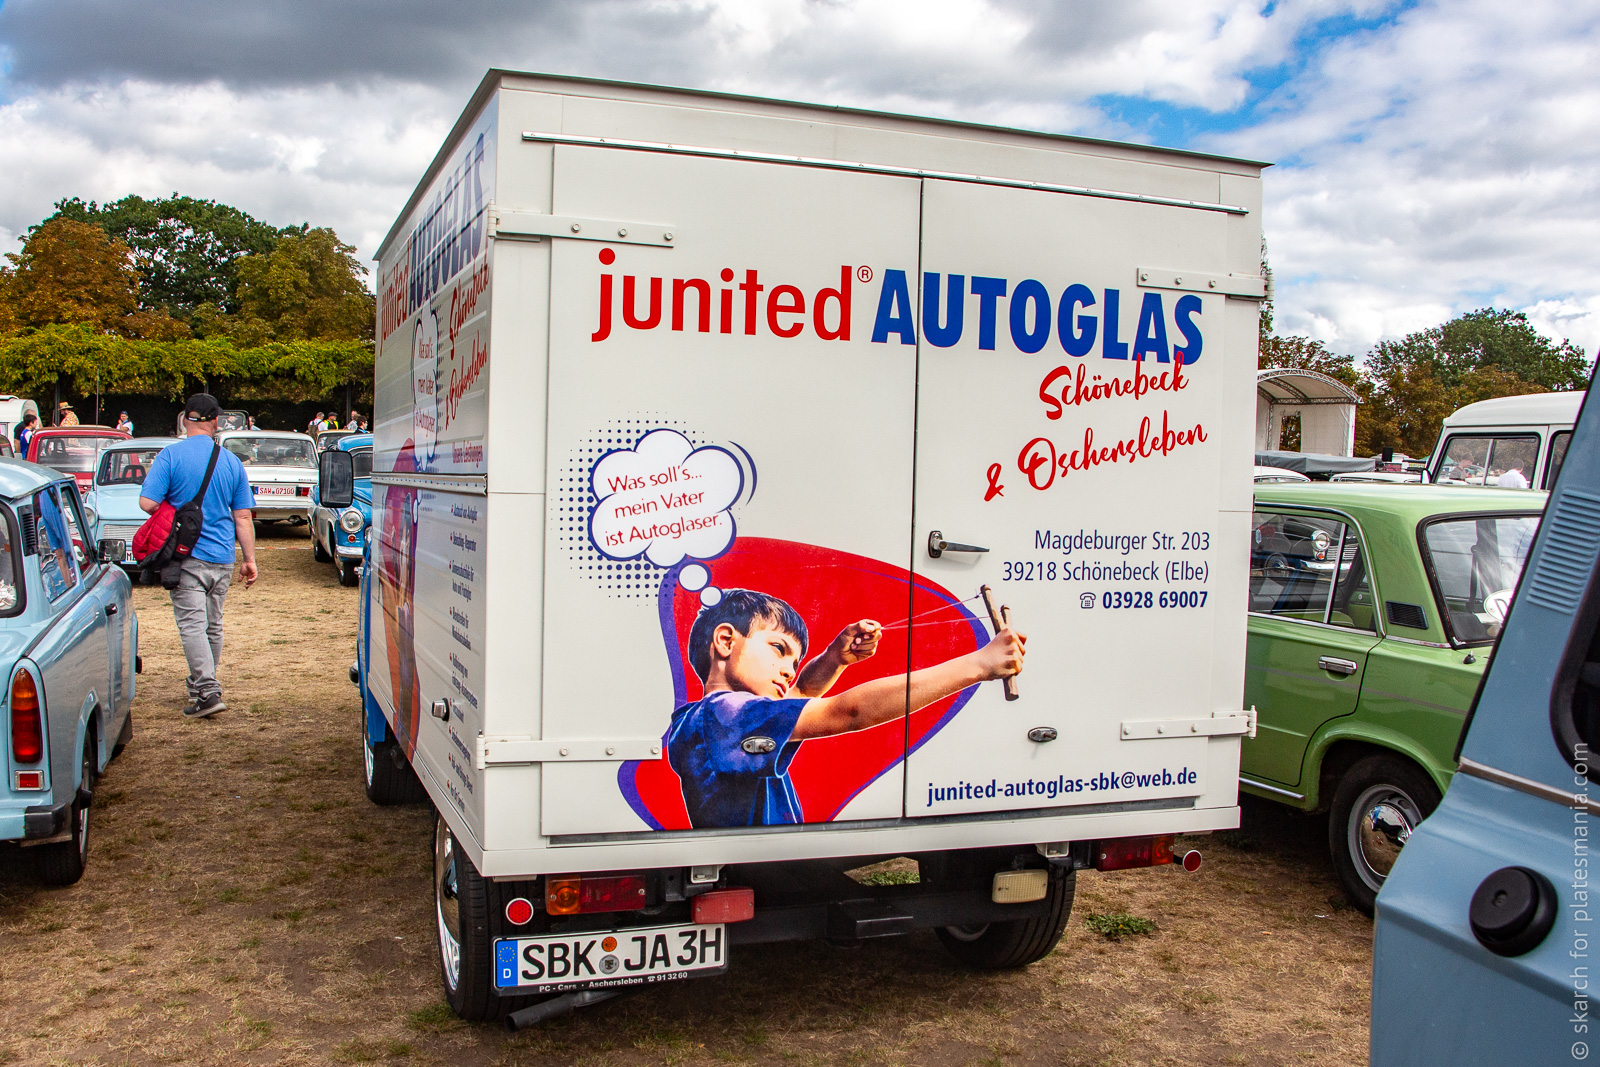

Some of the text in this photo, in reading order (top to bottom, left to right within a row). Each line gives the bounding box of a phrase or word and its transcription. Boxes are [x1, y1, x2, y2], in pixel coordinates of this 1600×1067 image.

[409, 133, 484, 315] AUTOGLAS
[871, 268, 1203, 365] AUTOGLAS
[1039, 351, 1189, 420] Schönebeck
[984, 410, 1208, 502] & Oschersleben
[608, 475, 646, 493] Was
[615, 491, 705, 519] mein Vater
[605, 514, 723, 546] ist Autoglaser.
[1035, 529, 1210, 555] Magdeburger Str. 203
[1002, 560, 1209, 583] 39218 Schönebeck (Elbe)
[1102, 591, 1208, 609] 03928 69007
[927, 767, 1197, 807] junited-autoglas-sbk@web.de
[502, 968, 512, 979] D
[521, 939, 597, 980] SBK
[539, 985, 551, 993] PC
[588, 976, 643, 989] Aschersleben
